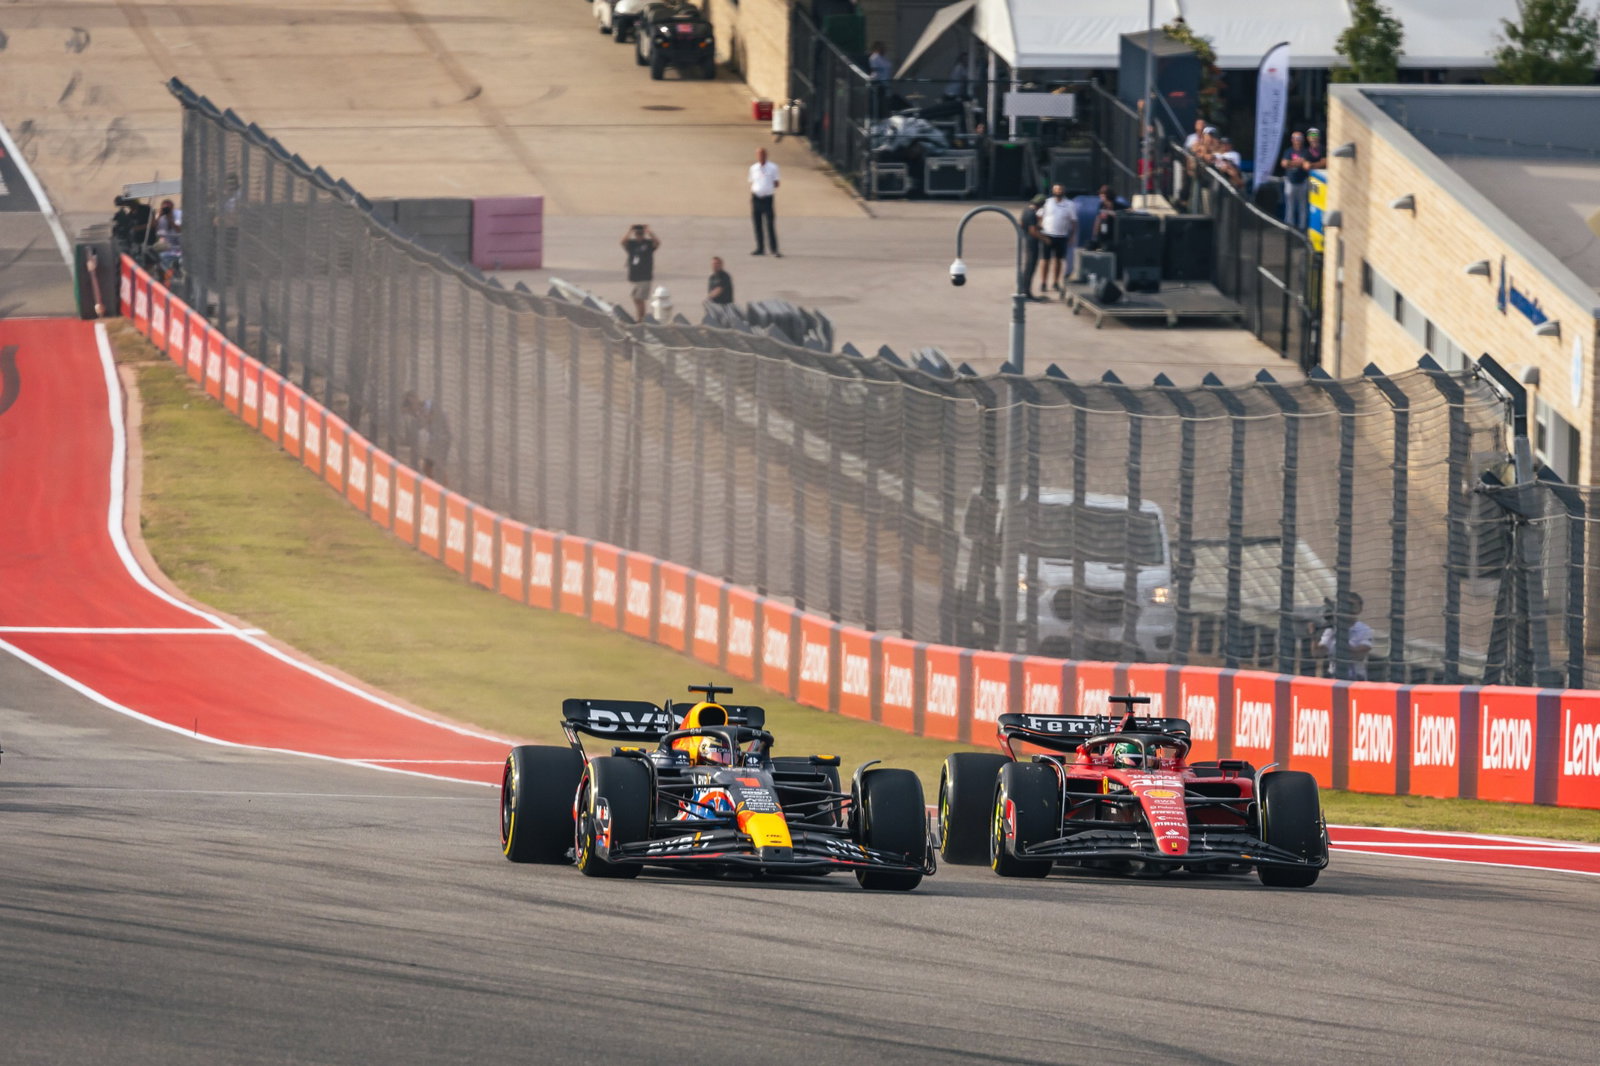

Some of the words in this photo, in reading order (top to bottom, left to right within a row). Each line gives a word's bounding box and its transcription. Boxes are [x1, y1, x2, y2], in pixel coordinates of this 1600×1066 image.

[1235, 688, 1273, 750] Lenovo
[1291, 696, 1331, 758] Lenovo
[1352, 700, 1395, 764] Lenovo
[1413, 704, 1457, 767] Lenovo
[1481, 705, 1534, 771] Lenovo
